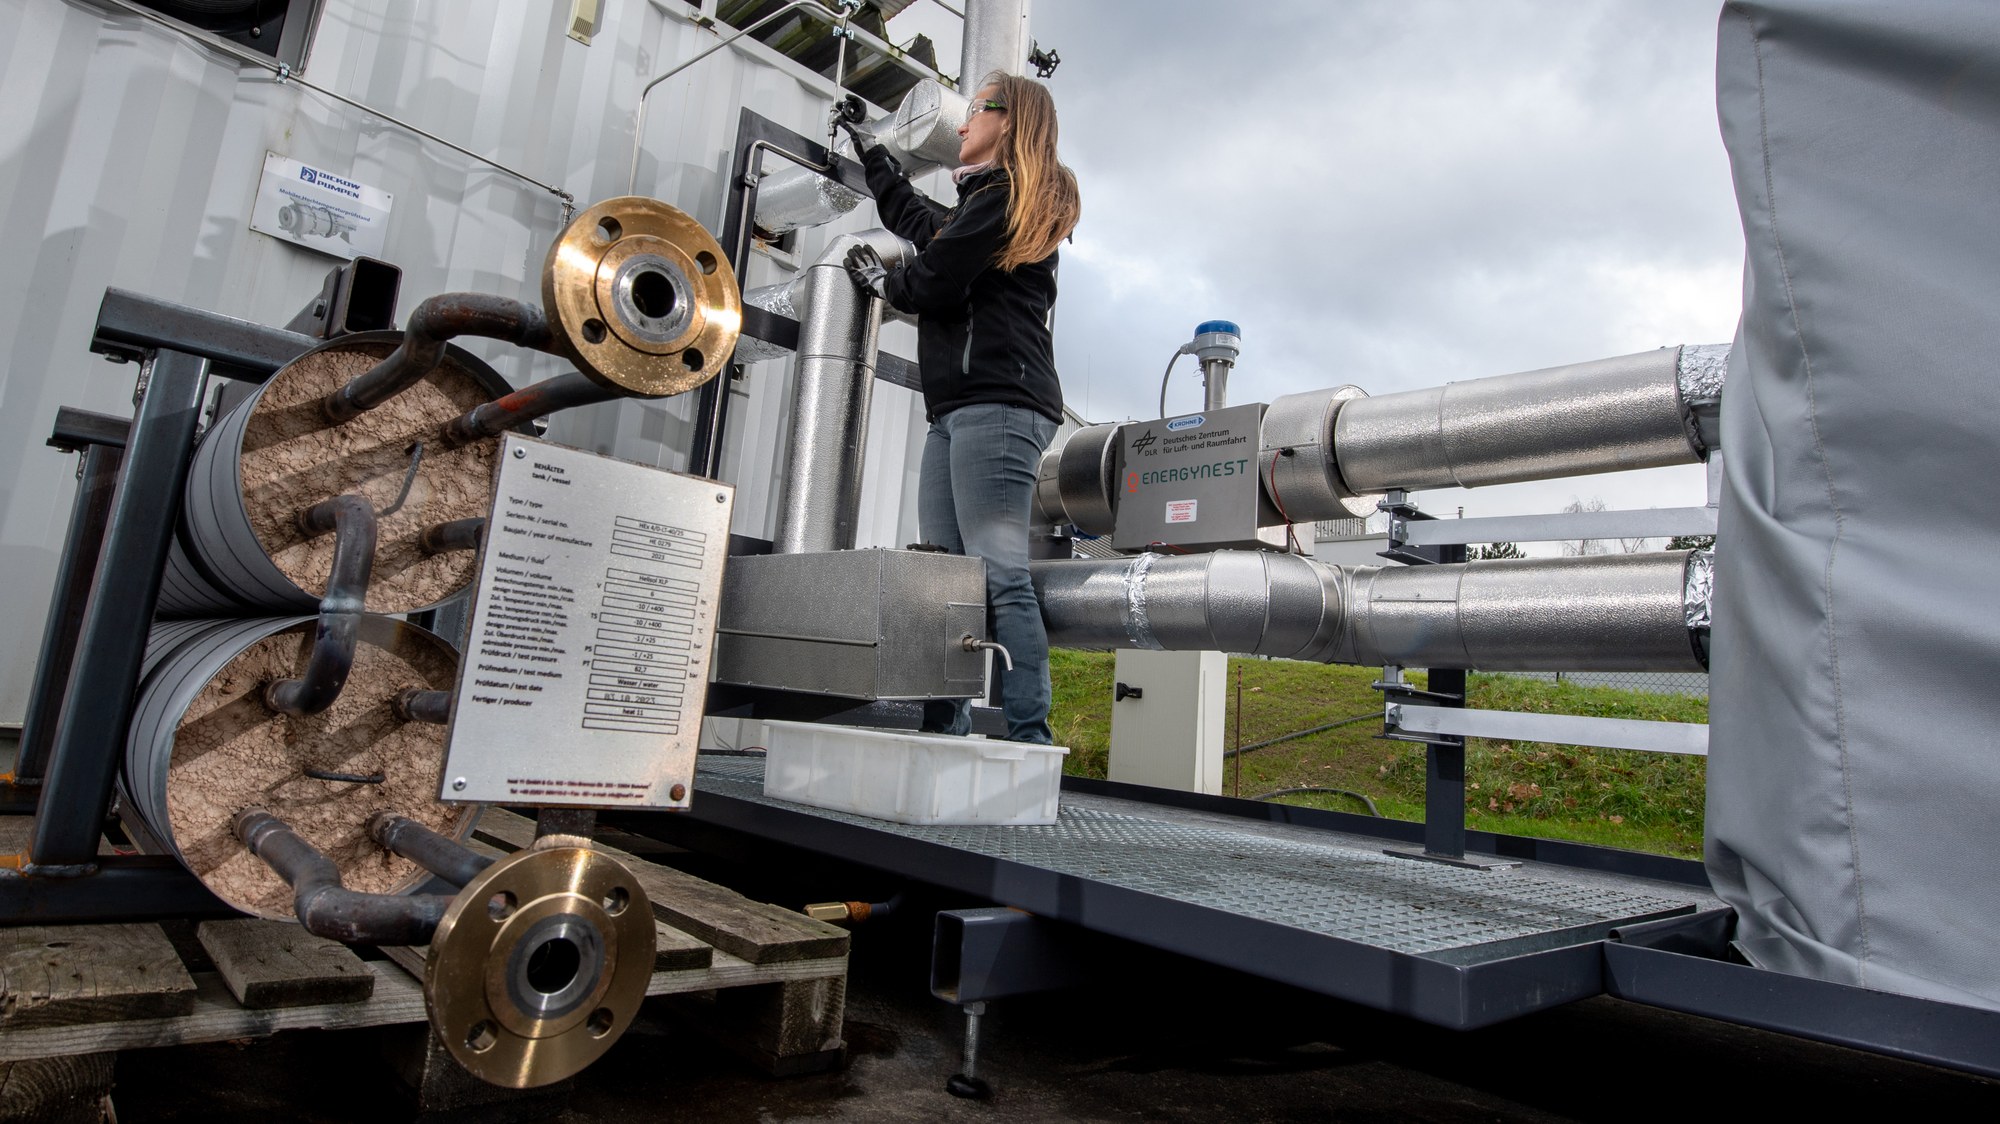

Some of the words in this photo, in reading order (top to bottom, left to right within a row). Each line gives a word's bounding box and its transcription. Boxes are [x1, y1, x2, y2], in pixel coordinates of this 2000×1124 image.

[319, 171, 360, 190] DICKOW
[317, 180, 359, 199] PUMPEN
[1174, 419, 1197, 427] KROHNE
[1163, 434, 1197, 445] Deutsches
[1199, 429, 1230, 440] Zentrum
[1163, 446, 1173, 454] für
[1174, 445, 1190, 453] Luft-
[1191, 441, 1205, 449] und
[1206, 436, 1247, 448] Raumfahrt
[1144, 449, 1158, 457] DLR
[534, 462, 565, 474] BEHÄLTER
[1142, 459, 1248, 484] ENERGYNEST
[532, 472, 546, 480] tank
[552, 477, 571, 485] vessel
[509, 496, 524, 505] Type
[529, 501, 543, 509] type
[506, 511, 536, 522] Serien-Nr.
[542, 519, 559, 527] serial
[503, 526, 528, 535] Baujahr
[555, 536, 593, 547] manufacture
[499, 552, 525, 561] Medium
[531, 557, 545, 565] fluid
[651, 553, 665, 561] 2023
[496, 566, 524, 577] Volumen
[530, 573, 552, 581] volume
[492, 586, 511, 594] design
[512, 588, 547, 599] temperature
[503, 595, 536, 606] Temperatur
[505, 606, 540, 616] temperature
[486, 621, 505, 630] design
[506, 624, 530, 632] pressure
[496, 630, 526, 641] Überdruck
[482, 640, 513, 648] admissible
[514, 643, 538, 651] pressure
[480, 648, 511, 658] Prüfdruck
[530, 655, 558, 663] pressure
[478, 663, 518, 674] Prüfmedium
[536, 670, 563, 678] medium
[475, 679, 509, 689] Prüfdatum
[617, 677, 637, 686] Wasser
[472, 695, 498, 704] Fertiger
[503, 698, 533, 706] producer
